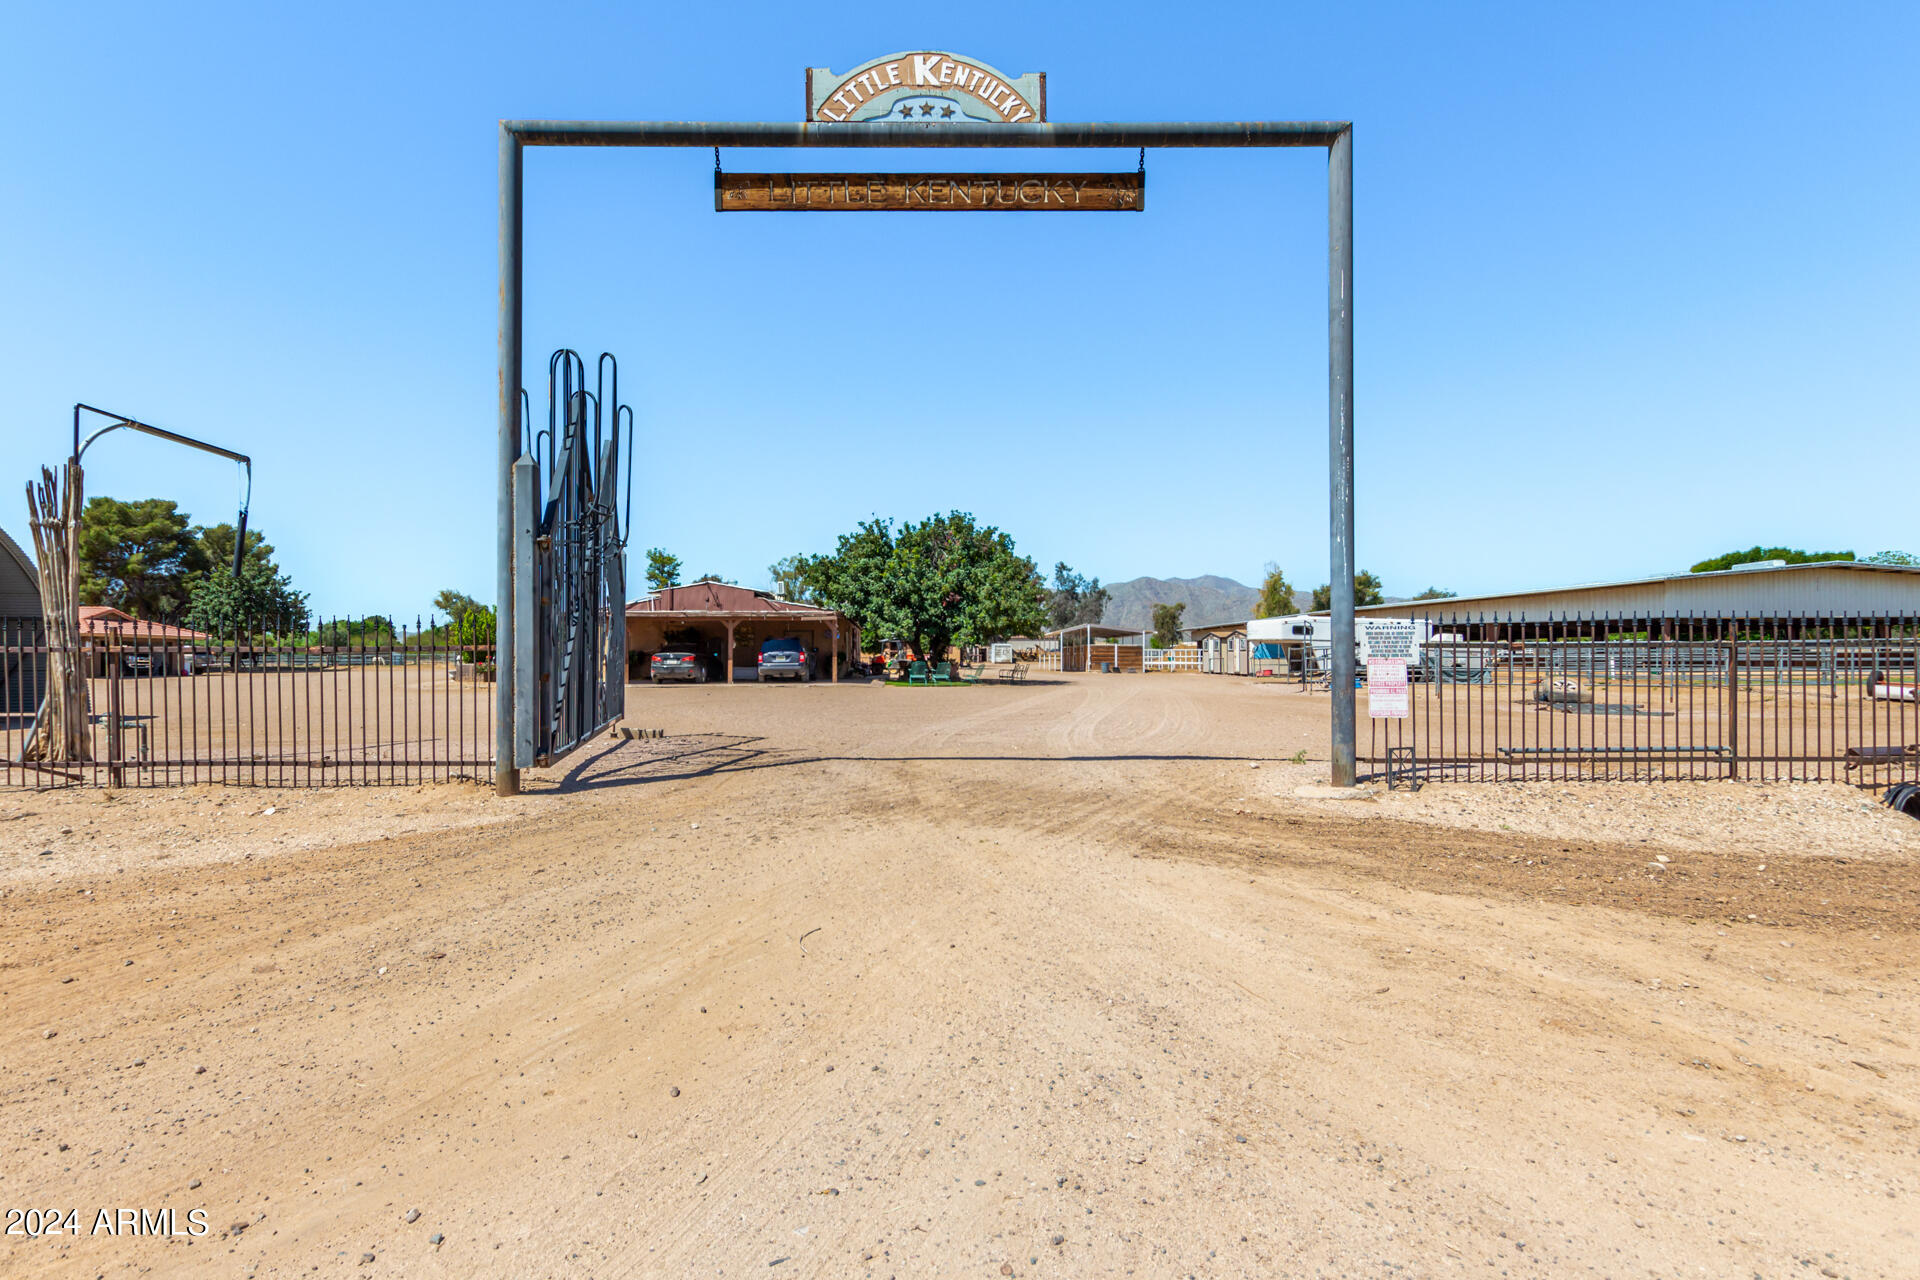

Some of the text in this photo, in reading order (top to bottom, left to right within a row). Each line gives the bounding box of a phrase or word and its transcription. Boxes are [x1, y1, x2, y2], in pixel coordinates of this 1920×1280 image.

[823, 55, 1032, 122] LITTLE KENTUCKY
[769, 179, 1088, 204] LITTLE KENTUCKY
